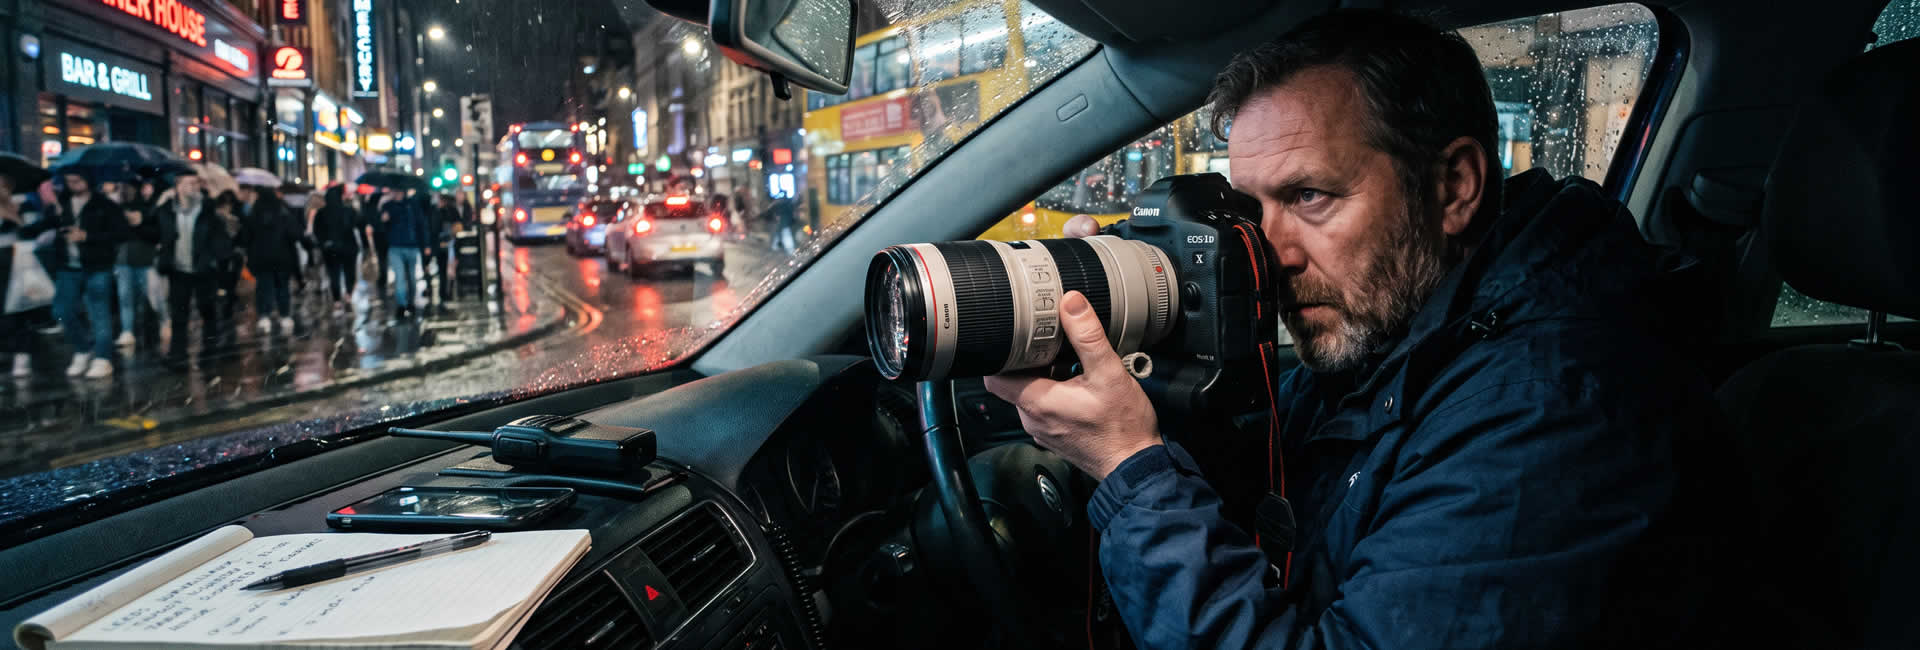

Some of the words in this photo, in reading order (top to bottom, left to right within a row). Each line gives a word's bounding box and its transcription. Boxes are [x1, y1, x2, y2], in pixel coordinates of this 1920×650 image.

[154, 0, 207, 47] HOUSE
[61, 52, 97, 88] BAR
[97, 62, 110, 92] &
[111, 66, 152, 101] GRILL
[1133, 206, 1160, 217] Canon
[1195, 254, 1204, 264] X
